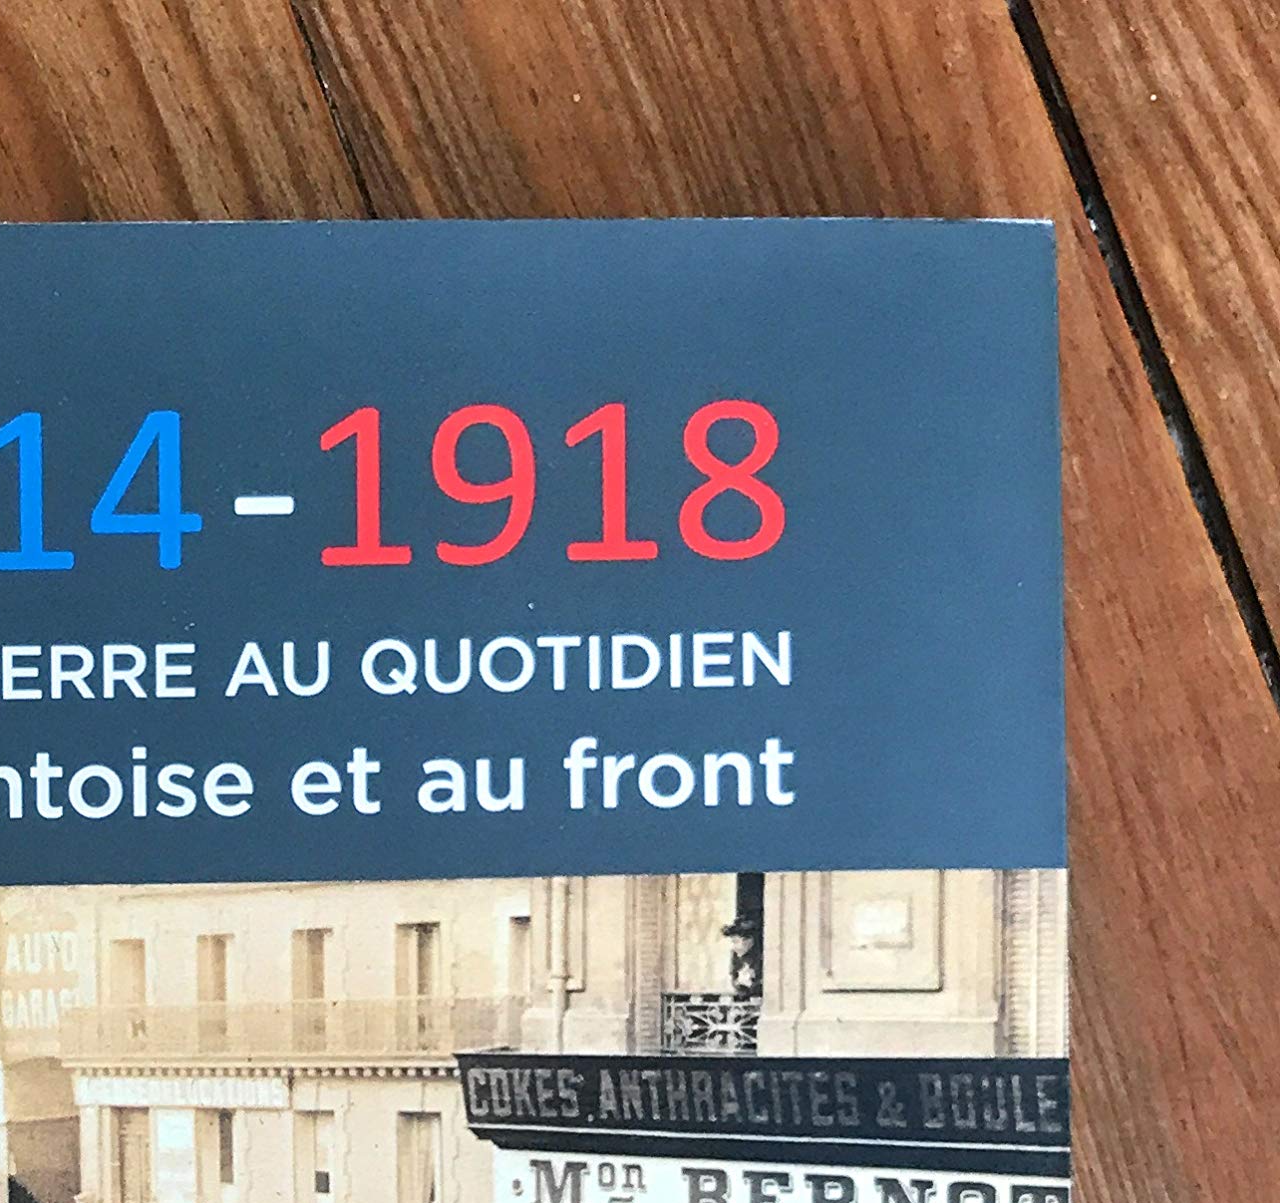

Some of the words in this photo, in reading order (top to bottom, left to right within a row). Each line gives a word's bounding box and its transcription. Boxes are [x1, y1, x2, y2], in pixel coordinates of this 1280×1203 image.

[225, 641, 330, 697] AU
[361, 630, 792, 695] QUOTIDIEN
[291, 747, 381, 816] et
[417, 757, 524, 813] au
[563, 736, 795, 809] front
[5, 930, 78, 973] AUTO
[598, 1069, 861, 1127] ANTHRACITES
[876, 1081, 907, 1129] &
[920, 1073, 1070, 1133] BOULE
